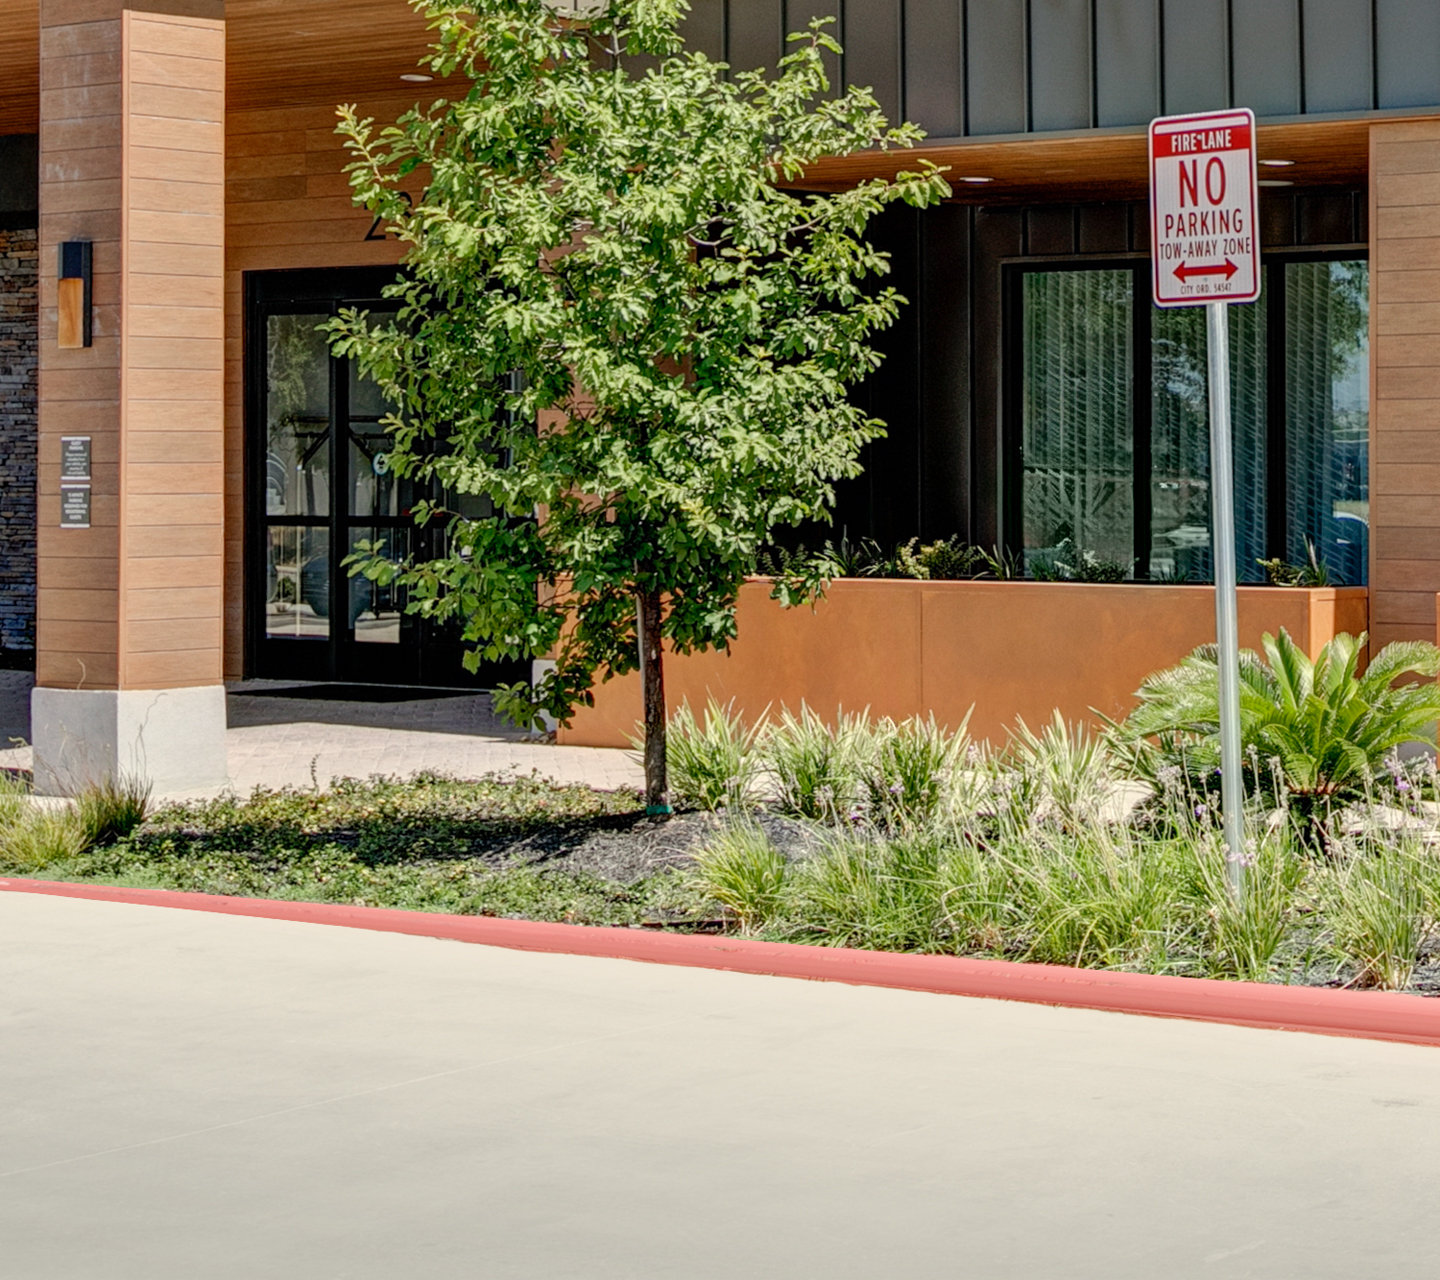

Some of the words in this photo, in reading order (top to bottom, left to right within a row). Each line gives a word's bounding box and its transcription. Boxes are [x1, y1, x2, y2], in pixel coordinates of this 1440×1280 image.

[1171, 133, 1198, 153] FIRE
[1201, 129, 1232, 150] LANE
[1178, 156, 1227, 208] NO
[1165, 208, 1244, 239] PARKING
[1160, 239, 1217, 260] TOW-AWAY
[1223, 236, 1251, 256] ZONE
[1180, 285, 1194, 295] CITY
